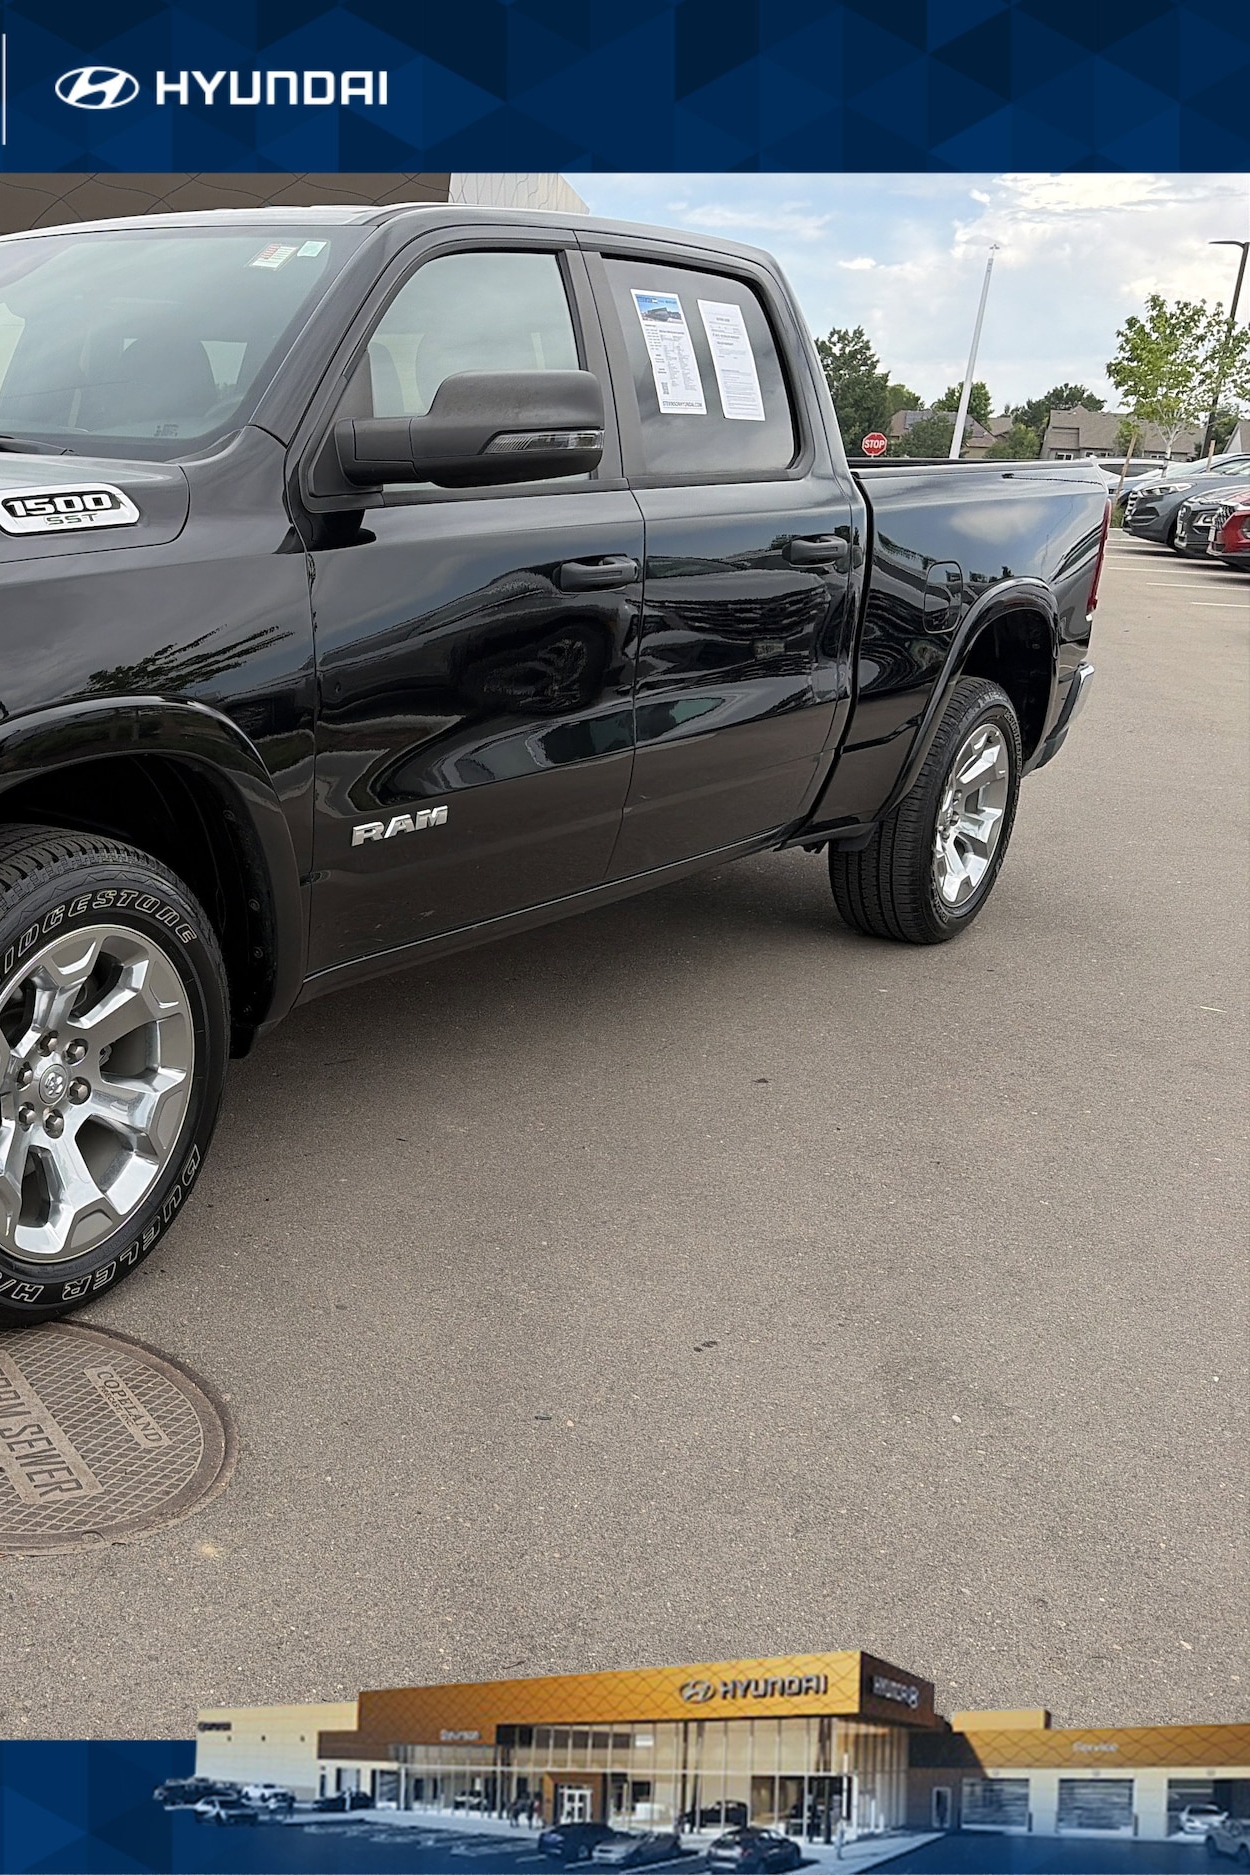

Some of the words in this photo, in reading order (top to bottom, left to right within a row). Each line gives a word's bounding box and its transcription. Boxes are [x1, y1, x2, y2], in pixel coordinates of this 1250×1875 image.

[864, 440, 885, 449] STOP
[6, 493, 112, 517] 1500
[45, 513, 98, 525] SST
[351, 805, 449, 847] RAM
[61, 1143, 202, 1301] DUELER
[96, 1371, 163, 1442] COPELAND
